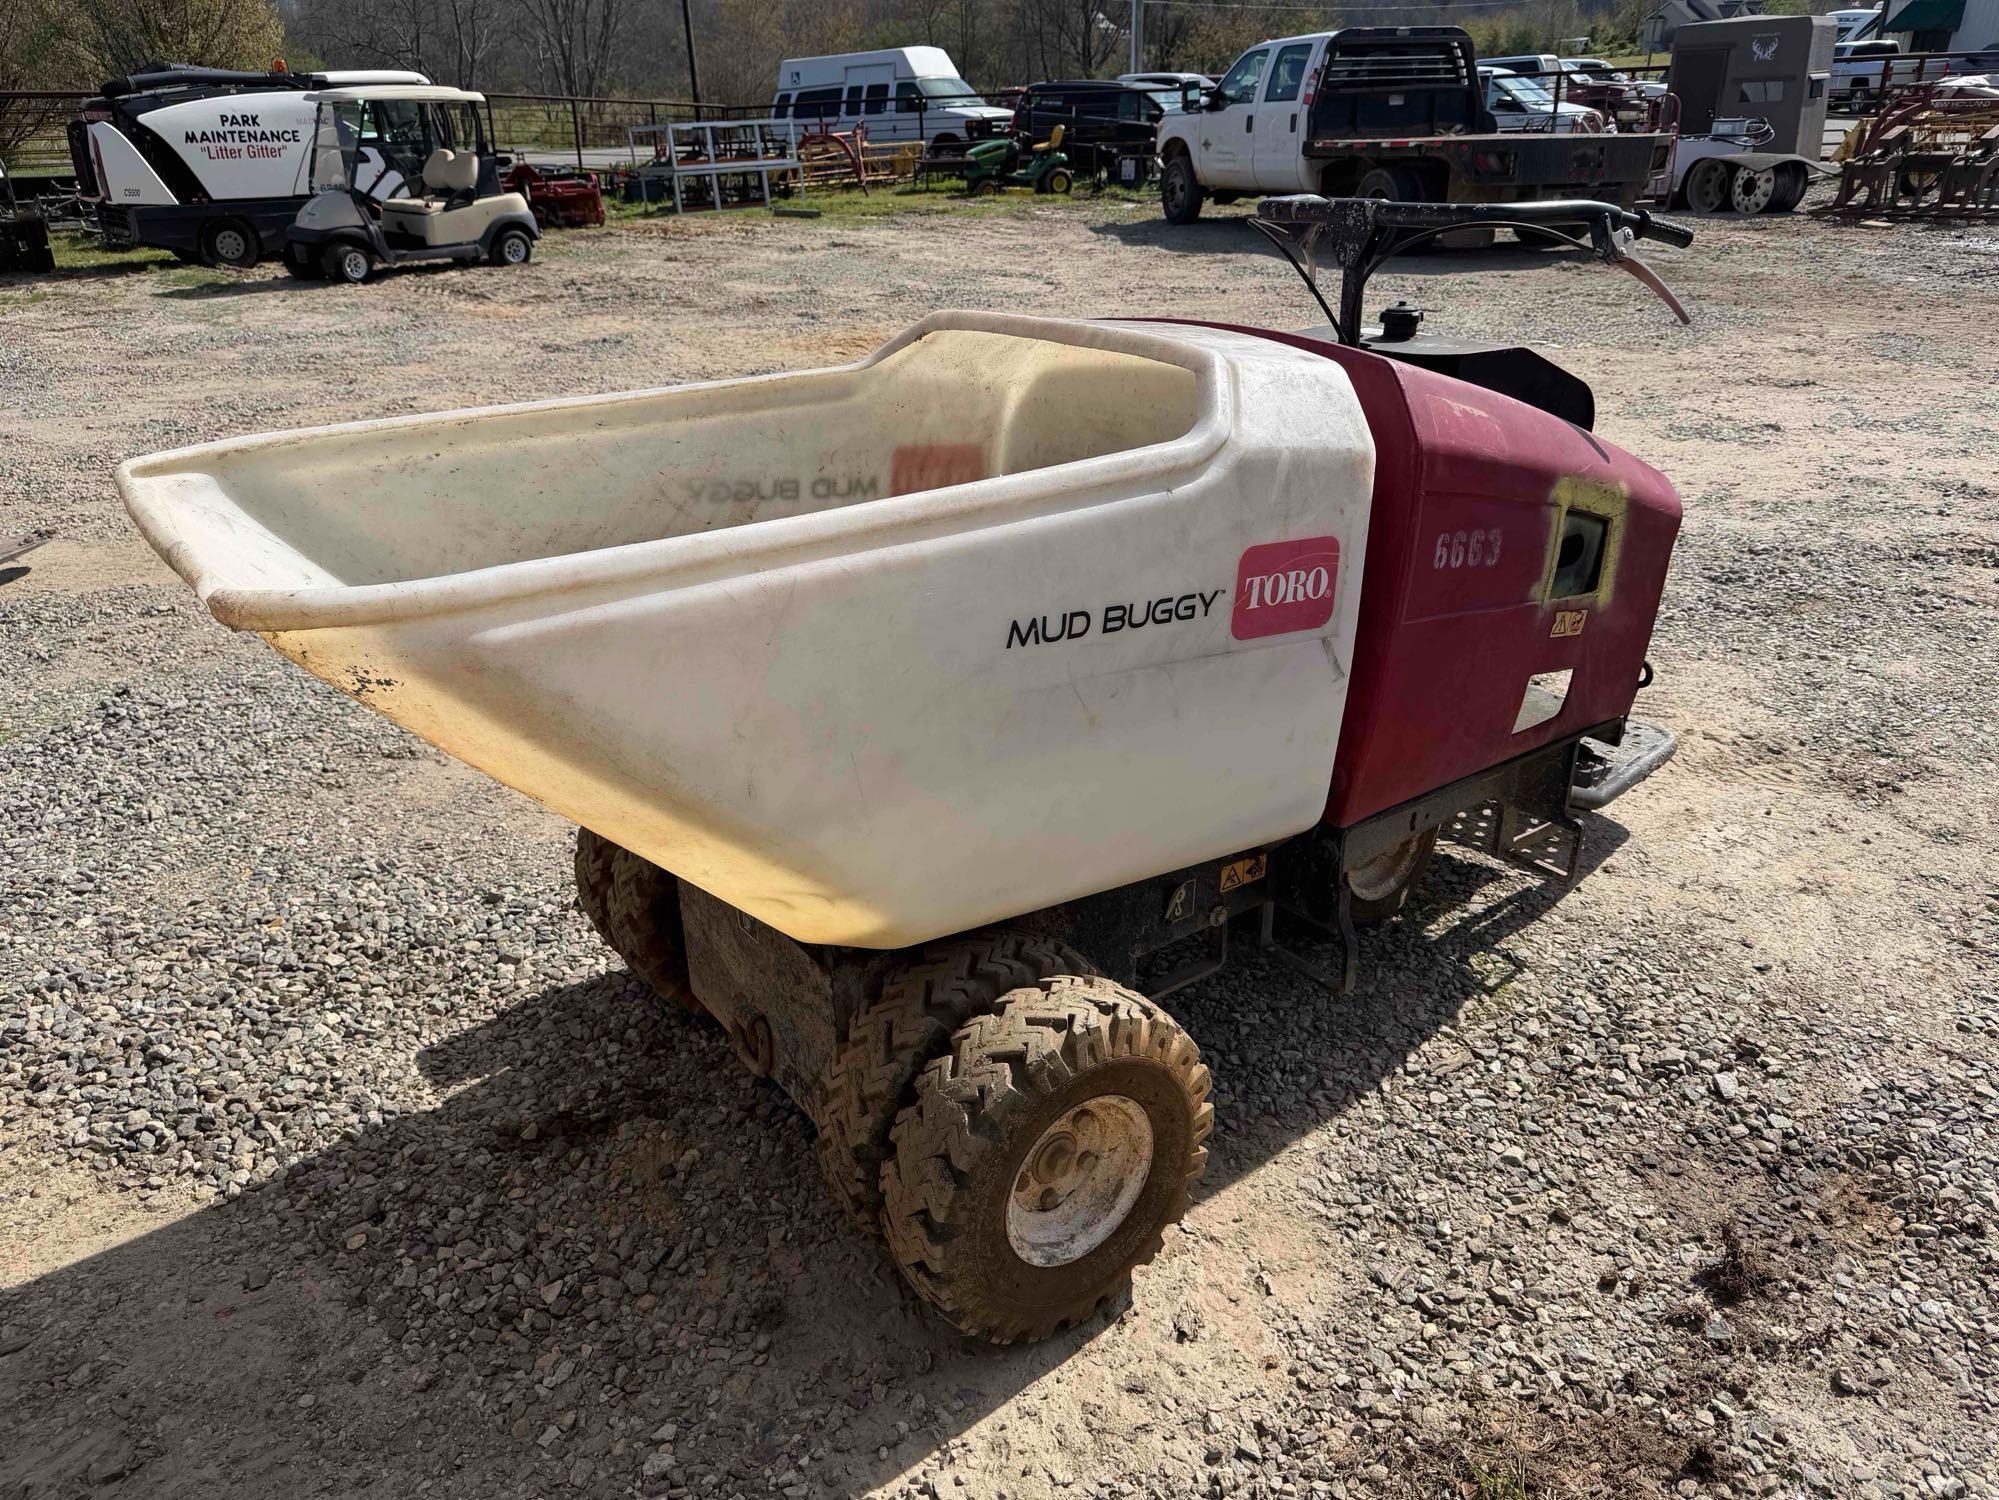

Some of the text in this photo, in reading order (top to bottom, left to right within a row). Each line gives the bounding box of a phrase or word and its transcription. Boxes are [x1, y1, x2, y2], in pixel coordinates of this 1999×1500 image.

[219, 114, 261, 127] PARK
[184, 130, 301, 144] MAINTENANCE
[200, 144, 288, 160] "Litter Gitter"
[1433, 527, 1502, 569] 6663
[1006, 591, 1220, 649] MUD BUGGY
